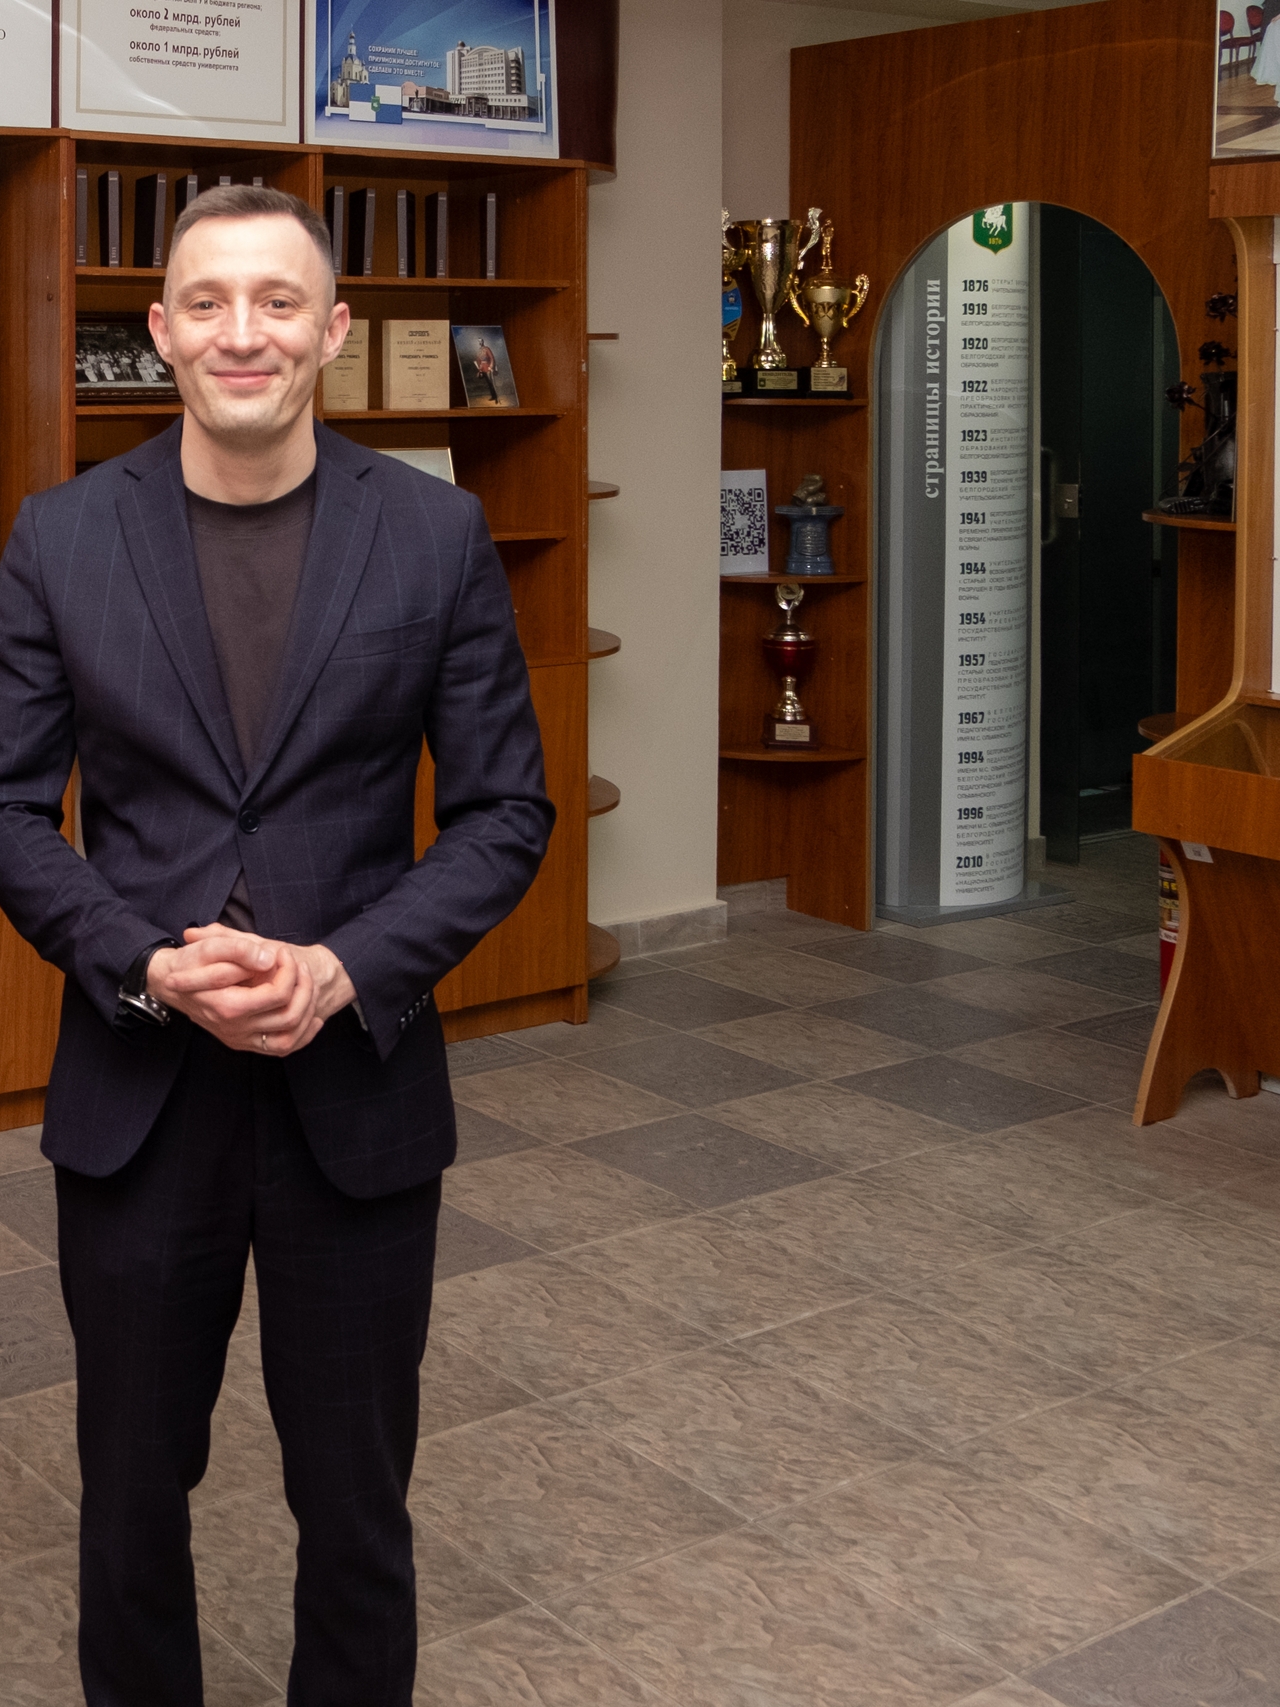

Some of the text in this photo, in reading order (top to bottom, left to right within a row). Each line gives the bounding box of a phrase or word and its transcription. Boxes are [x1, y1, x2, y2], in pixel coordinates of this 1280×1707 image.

[237, 2, 263, 11] региона;
[130, 8, 241, 28] около 2 млрд. рублей
[150, 23, 221, 37] федеральных средств;
[129, 41, 240, 59] около 1 млрд. рублей
[368, 45, 396, 54] СОХРАНИМ
[129, 56, 239, 72] собственных средств университета
[962, 280, 989, 292] 1876
[962, 303, 988, 315] 1919
[962, 337, 988, 350] 1920
[925, 279, 946, 499] страницы истории
[961, 380, 988, 393] 1922
[961, 429, 988, 442] 1923
[960, 471, 987, 484] 1939
[960, 512, 986, 525] 1941
[960, 562, 986, 575] 1944
[959, 612, 986, 625] 1954
[958, 653, 986, 667] 1957
[958, 711, 985, 725] 1967
[957, 751, 984, 764] 1994
[957, 807, 984, 820] 1996
[956, 855, 983, 869] 2010
